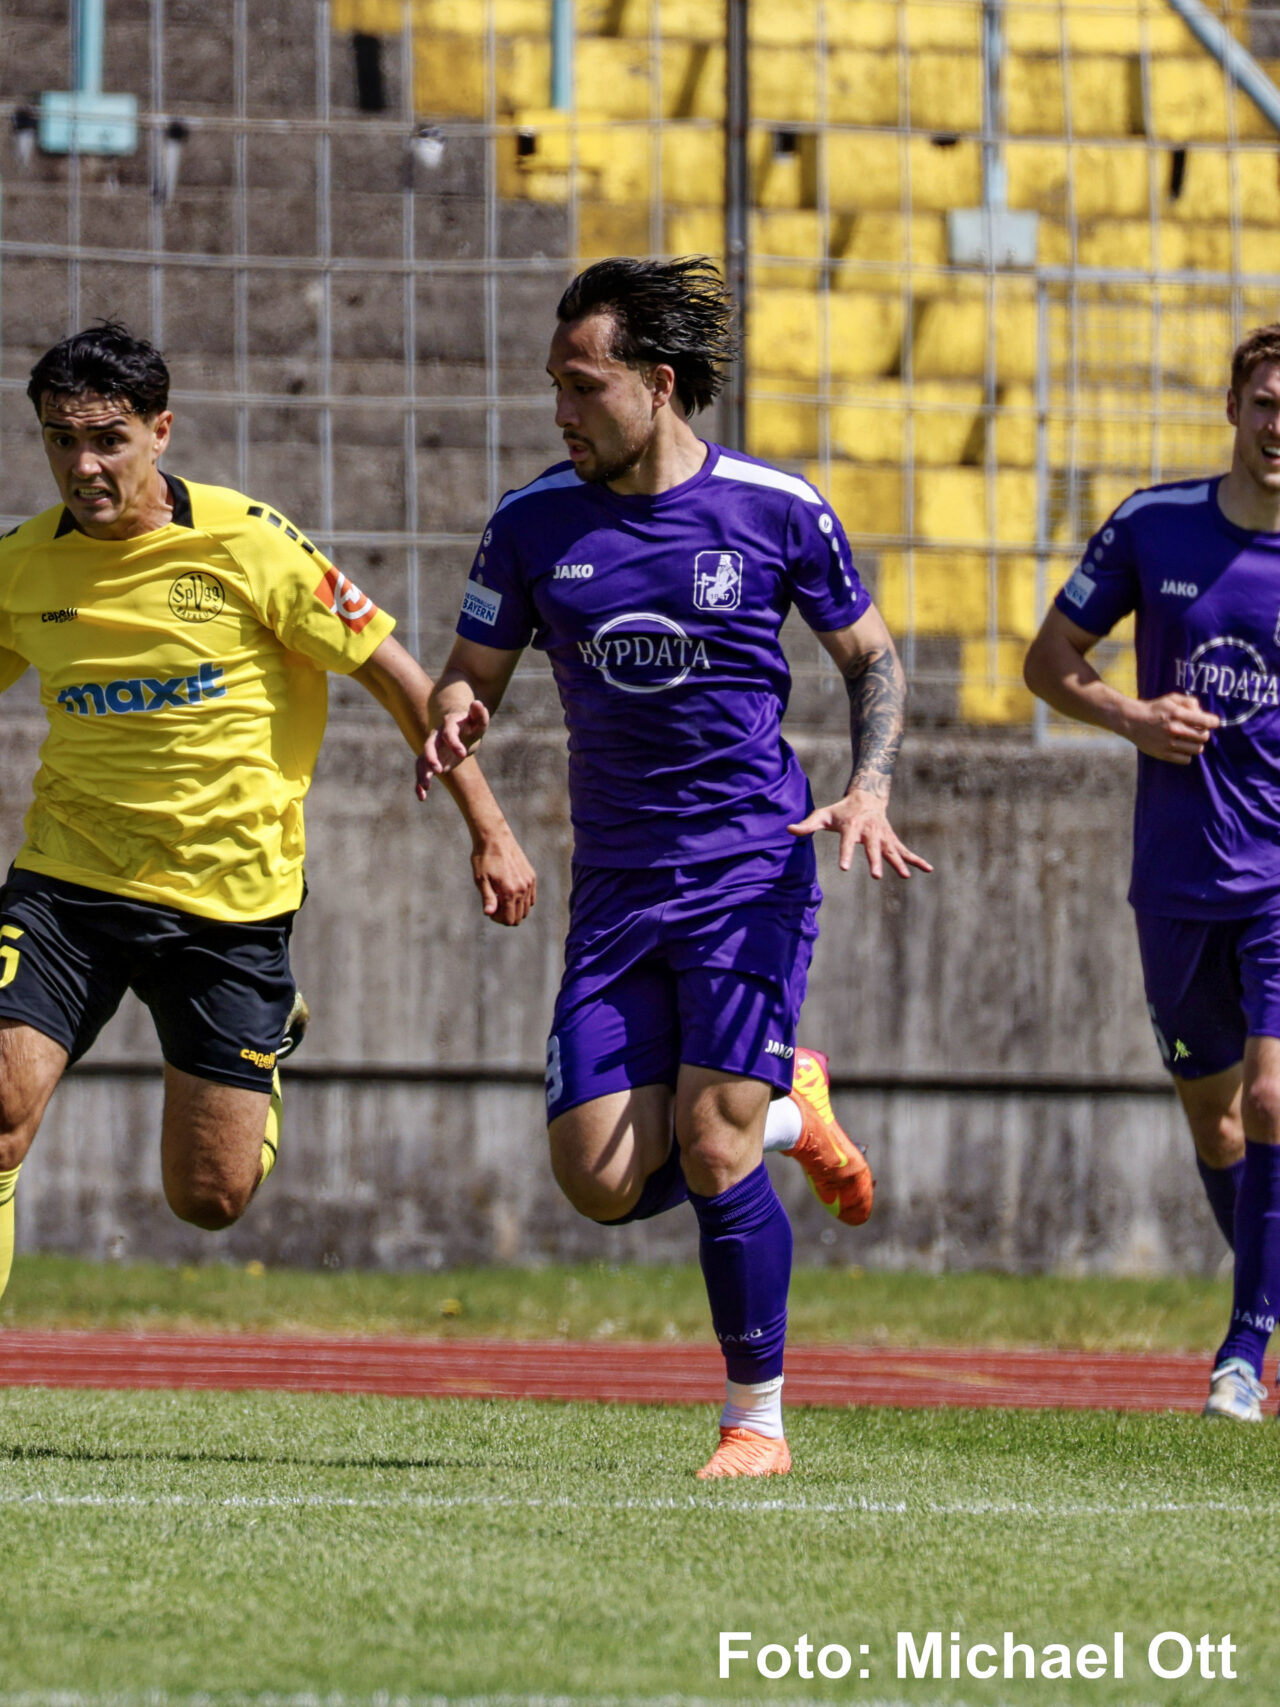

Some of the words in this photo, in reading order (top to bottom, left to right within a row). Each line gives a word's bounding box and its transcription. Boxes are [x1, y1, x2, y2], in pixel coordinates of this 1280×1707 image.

[553, 564, 594, 579] JAKO
[1160, 578, 1199, 598] JAKO
[41, 607, 78, 623] capelli
[462, 598, 495, 622] BAYERN
[577, 636, 711, 670] HYPDATA
[57, 662, 227, 716] maxit
[1175, 657, 1279, 706] HYPDATA
[764, 1039, 794, 1059] JAKO
[1234, 1308, 1275, 1332] JAKO
